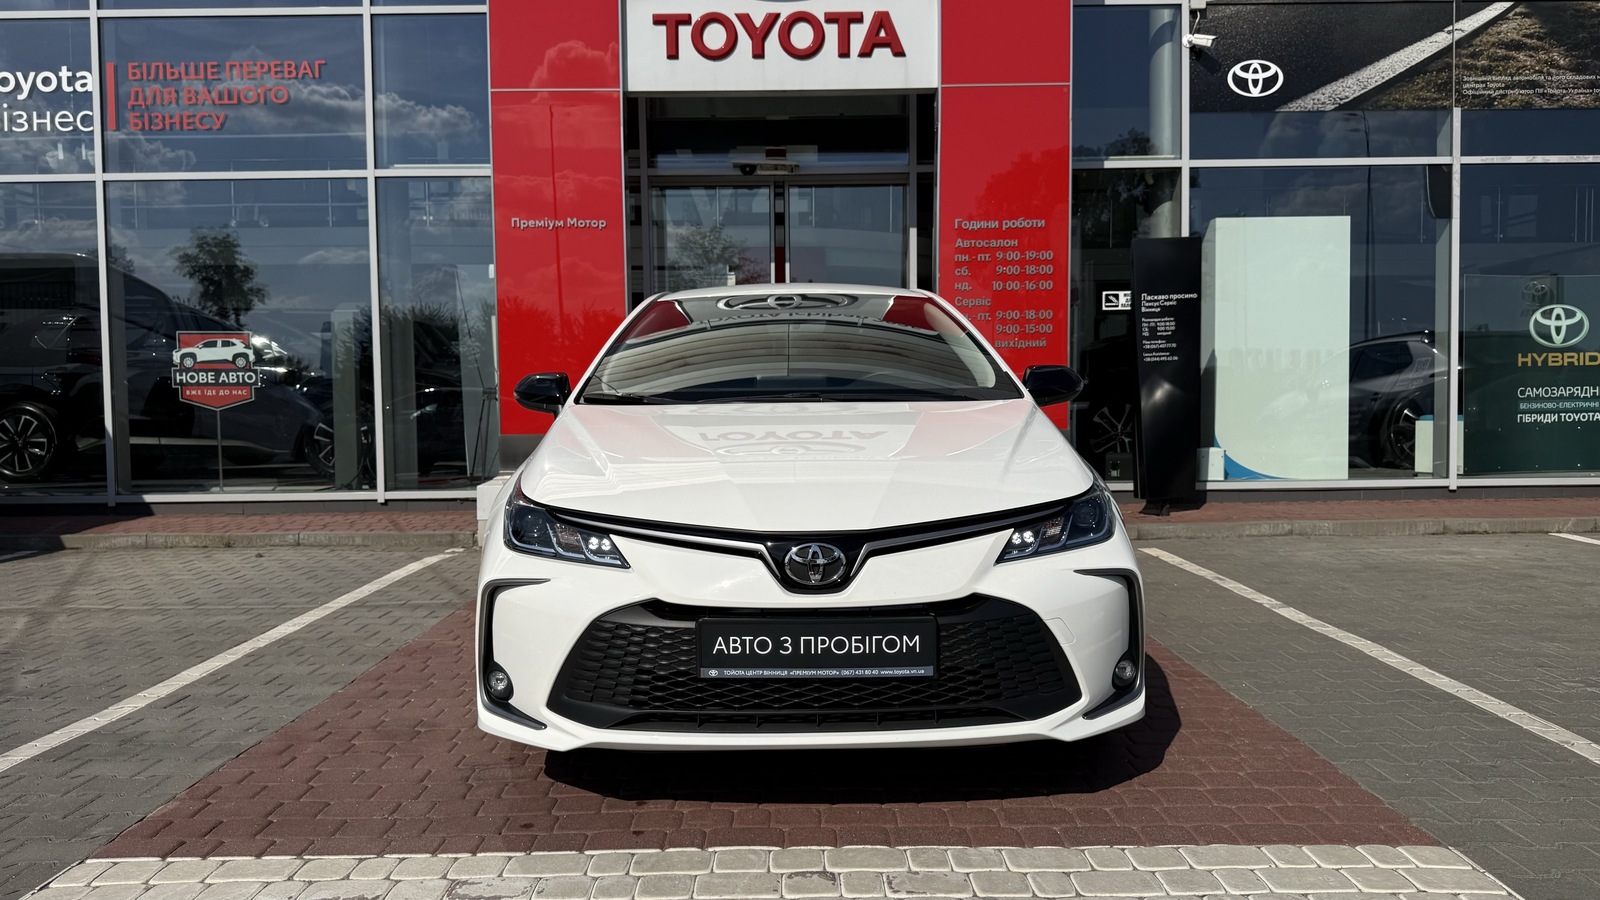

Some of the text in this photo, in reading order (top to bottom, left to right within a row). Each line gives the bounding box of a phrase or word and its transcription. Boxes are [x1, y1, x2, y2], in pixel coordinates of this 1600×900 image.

[652, 10, 907, 61] TOYOTA
[128, 60, 326, 80] БІЛЬШЕ ПЕРЕВАГ
[127, 85, 289, 110] ДЛЯ ВАШОГО
[129, 111, 226, 131] БІЗНЕСУ
[511, 217, 607, 230] Преміум Мотор
[955, 217, 1045, 231] Години роботи
[955, 238, 1018, 248] Автосалон
[955, 266, 971, 276] сб.
[955, 282, 972, 291] нд.
[955, 296, 991, 308] Сервіс
[995, 338, 1047, 349] вихідний
[1518, 351, 1600, 367] HYBRID
[176, 371, 256, 384] НОВЕ АВТО
[1517, 386, 1599, 399] САМОЗАРЯДН
[1520, 401, 1600, 410] БЕНЗИНОВО-ЕЛЕКТРИЧНІ
[1517, 412, 1600, 424] ГІБРИДИ TOYOTA
[712, 634, 920, 655] АВТО З ПРОБІГОМ
[746, 669, 763, 677] ЦЕНТР
[763, 669, 788, 677] ВІННИЦЯ
[880, 668, 925, 676] www.toyota.vn.ua
